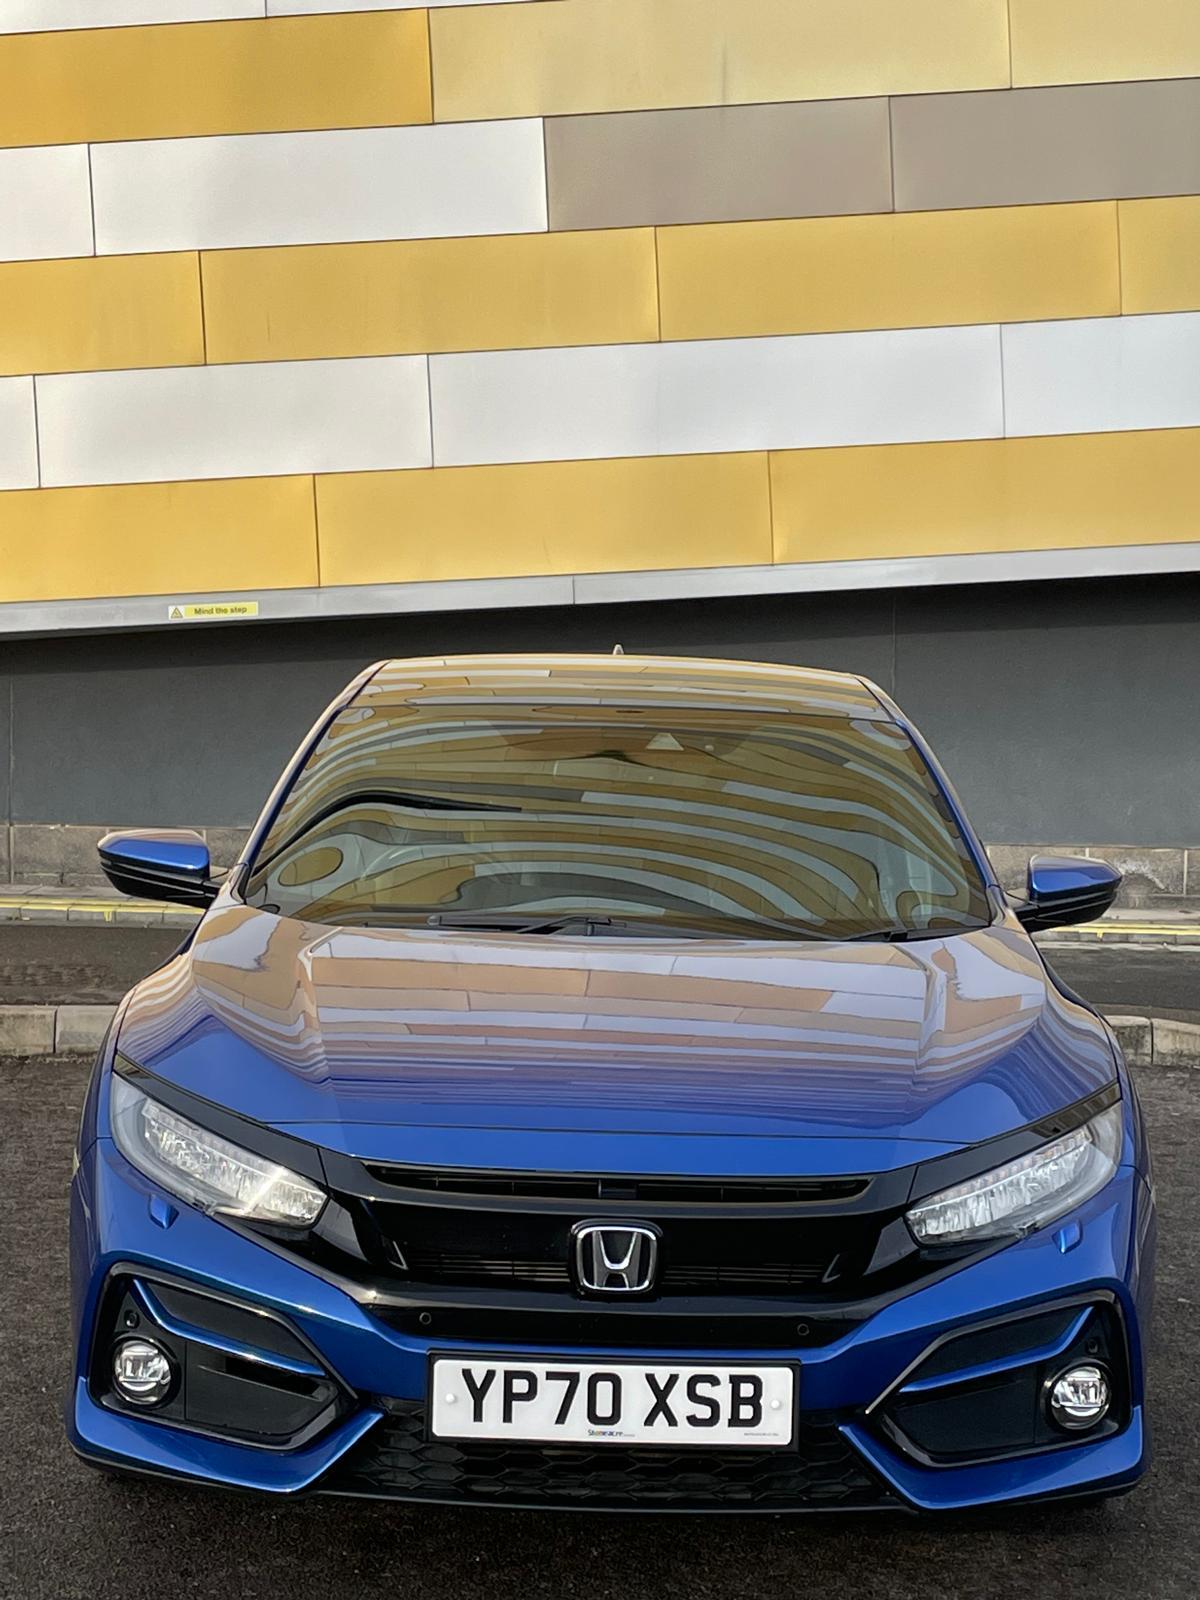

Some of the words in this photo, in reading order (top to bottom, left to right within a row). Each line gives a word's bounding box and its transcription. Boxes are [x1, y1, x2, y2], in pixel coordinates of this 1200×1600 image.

[230, 607, 247, 615] step
[462, 1368, 622, 1426] YP70
[643, 1373, 763, 1428] XSB
